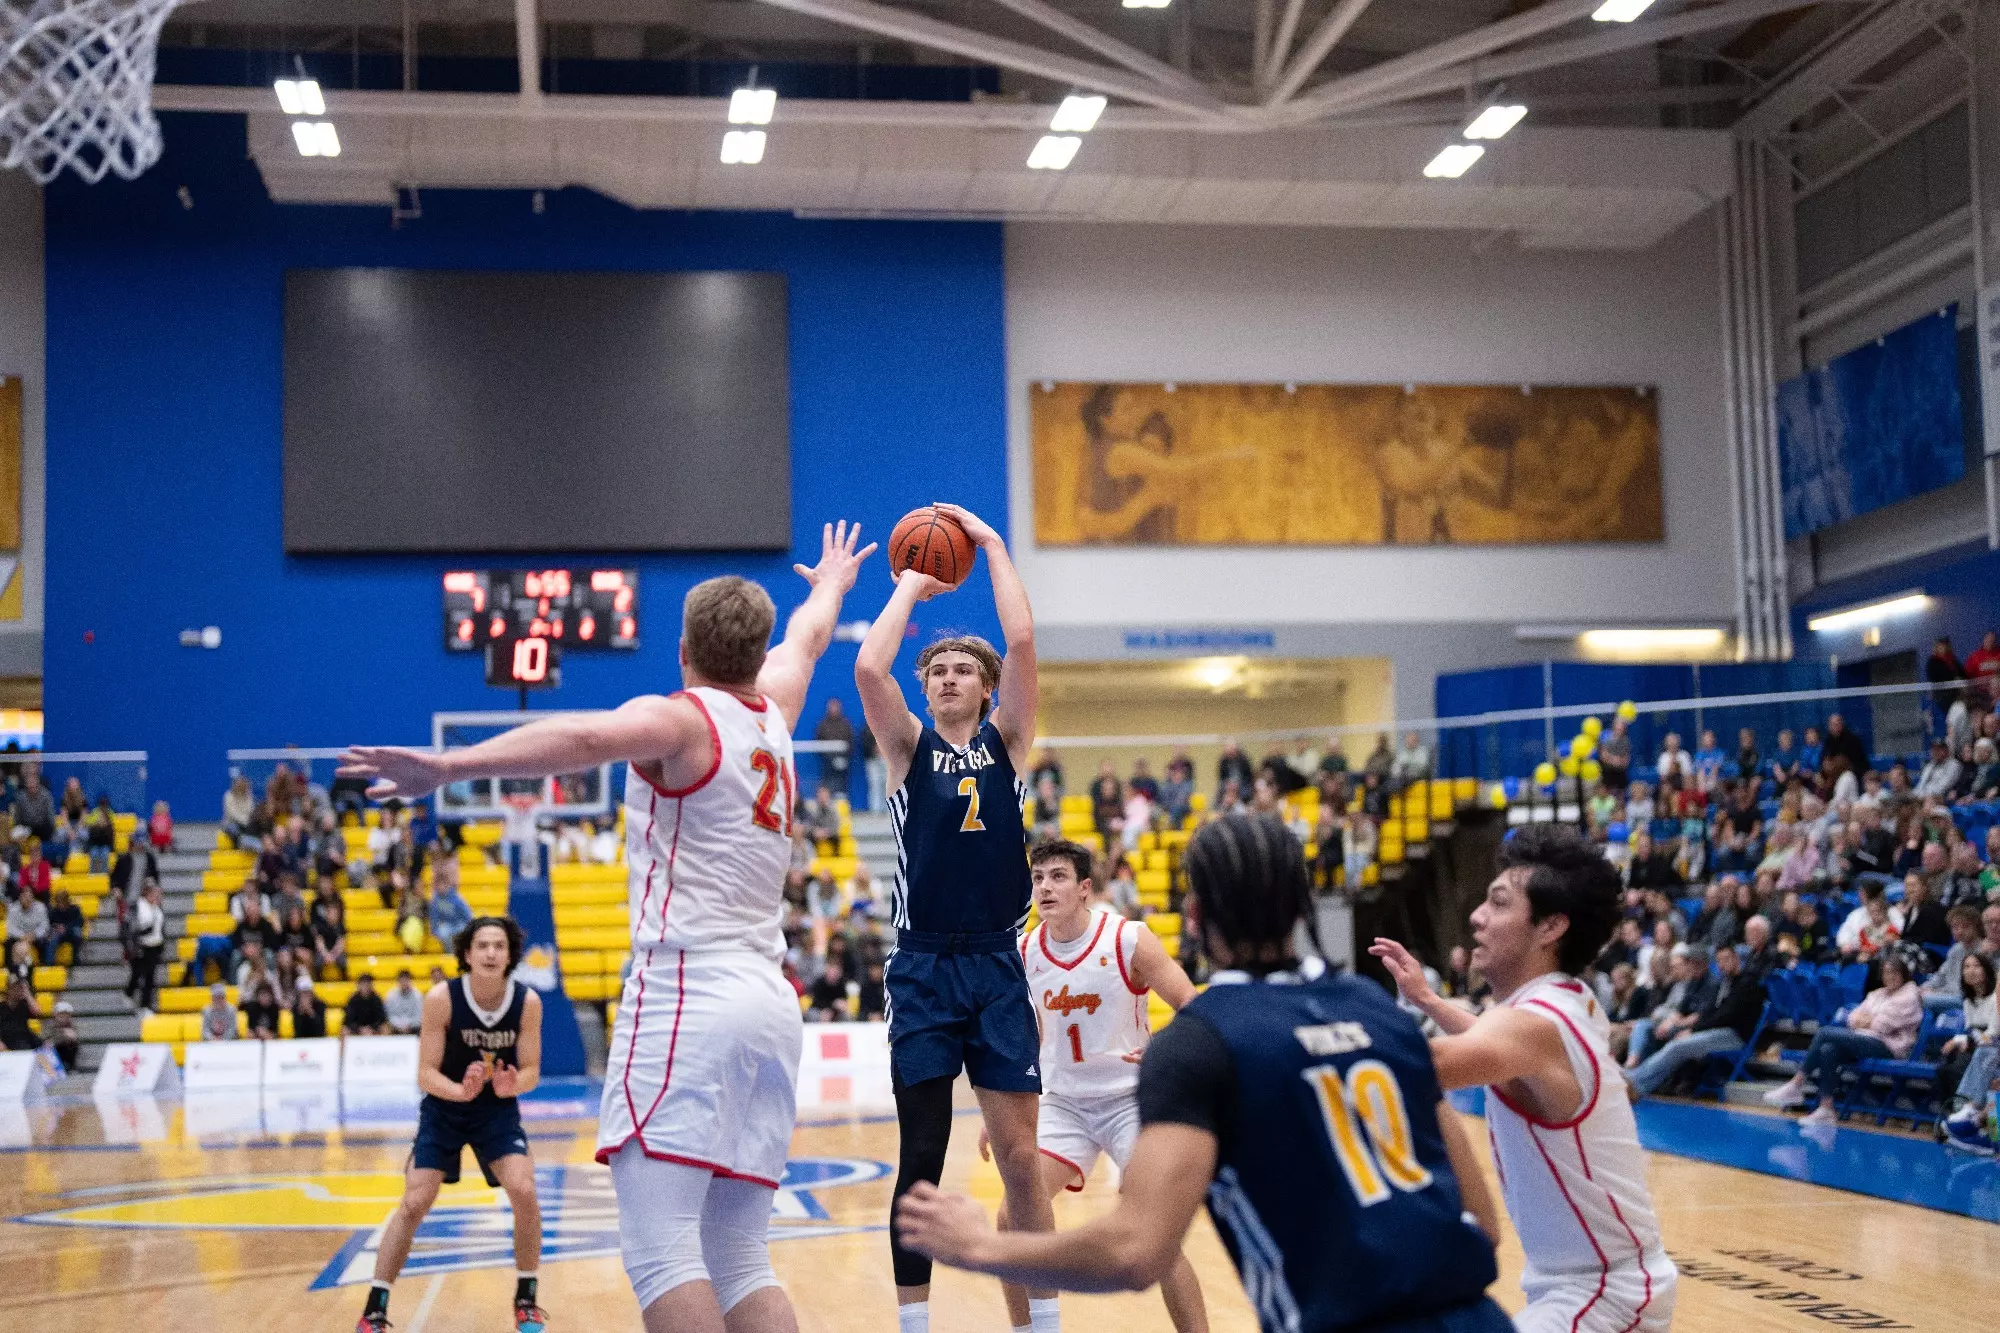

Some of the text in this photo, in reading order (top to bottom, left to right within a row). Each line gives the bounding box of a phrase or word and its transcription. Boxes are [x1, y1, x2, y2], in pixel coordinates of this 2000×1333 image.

[513, 637, 548, 682] 10
[750, 747, 794, 837] 21
[958, 777, 986, 832] 2
[1043, 984, 1102, 1017] Calgary
[1067, 1023, 1084, 1063] 1
[1300, 1058, 1434, 1208] 10
[1712, 1248, 1864, 1280] COURT
[1782, 1303, 1915, 1330] KEN
